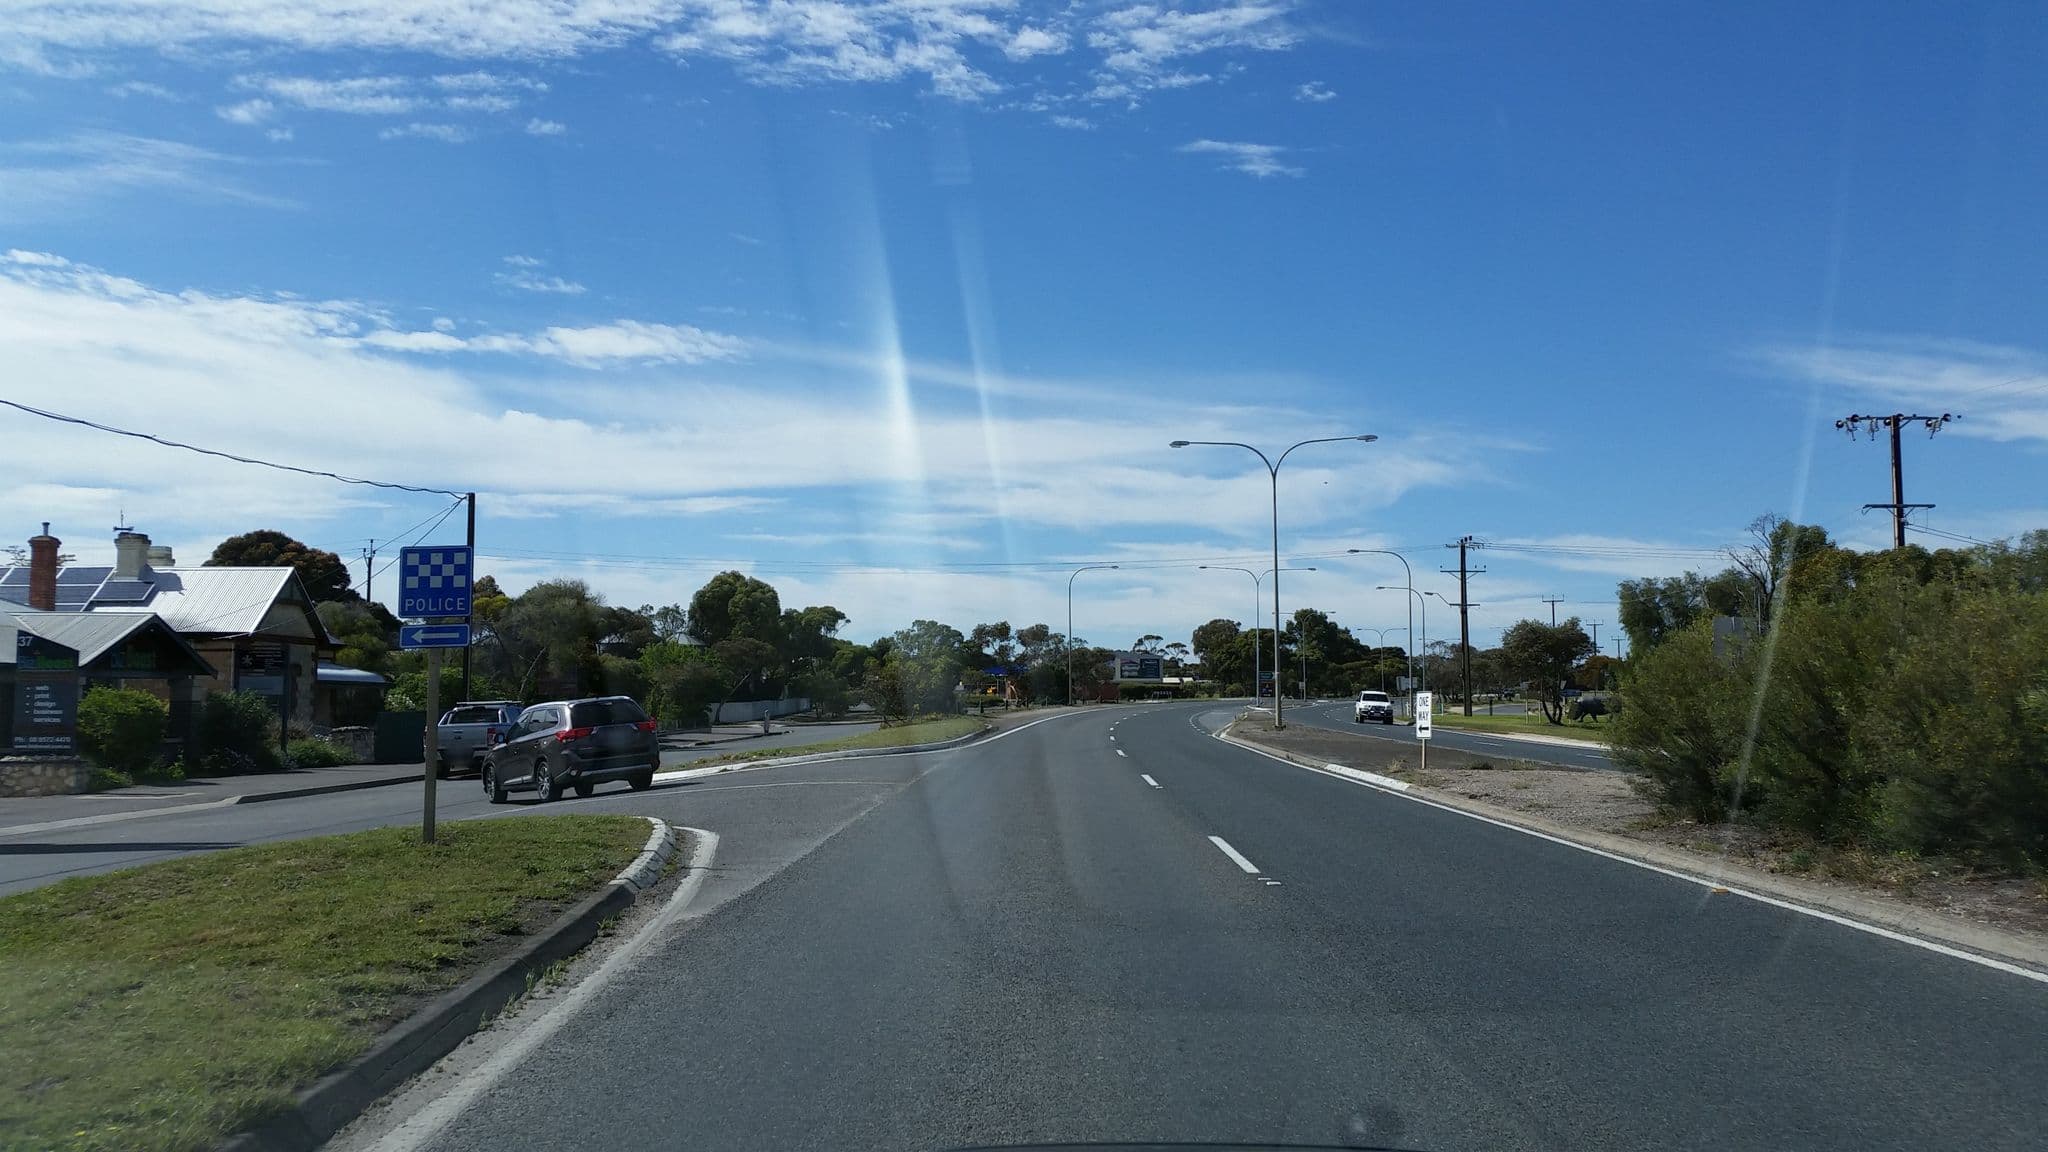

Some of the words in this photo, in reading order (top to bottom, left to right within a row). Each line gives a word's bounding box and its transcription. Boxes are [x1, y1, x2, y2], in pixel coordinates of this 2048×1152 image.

[405, 597, 466, 611] POLICE
[18, 635, 33, 647] 37
[33, 700, 57, 708] design
[1418, 696, 1429, 707] ONE
[1418, 711, 1429, 721] WAY
